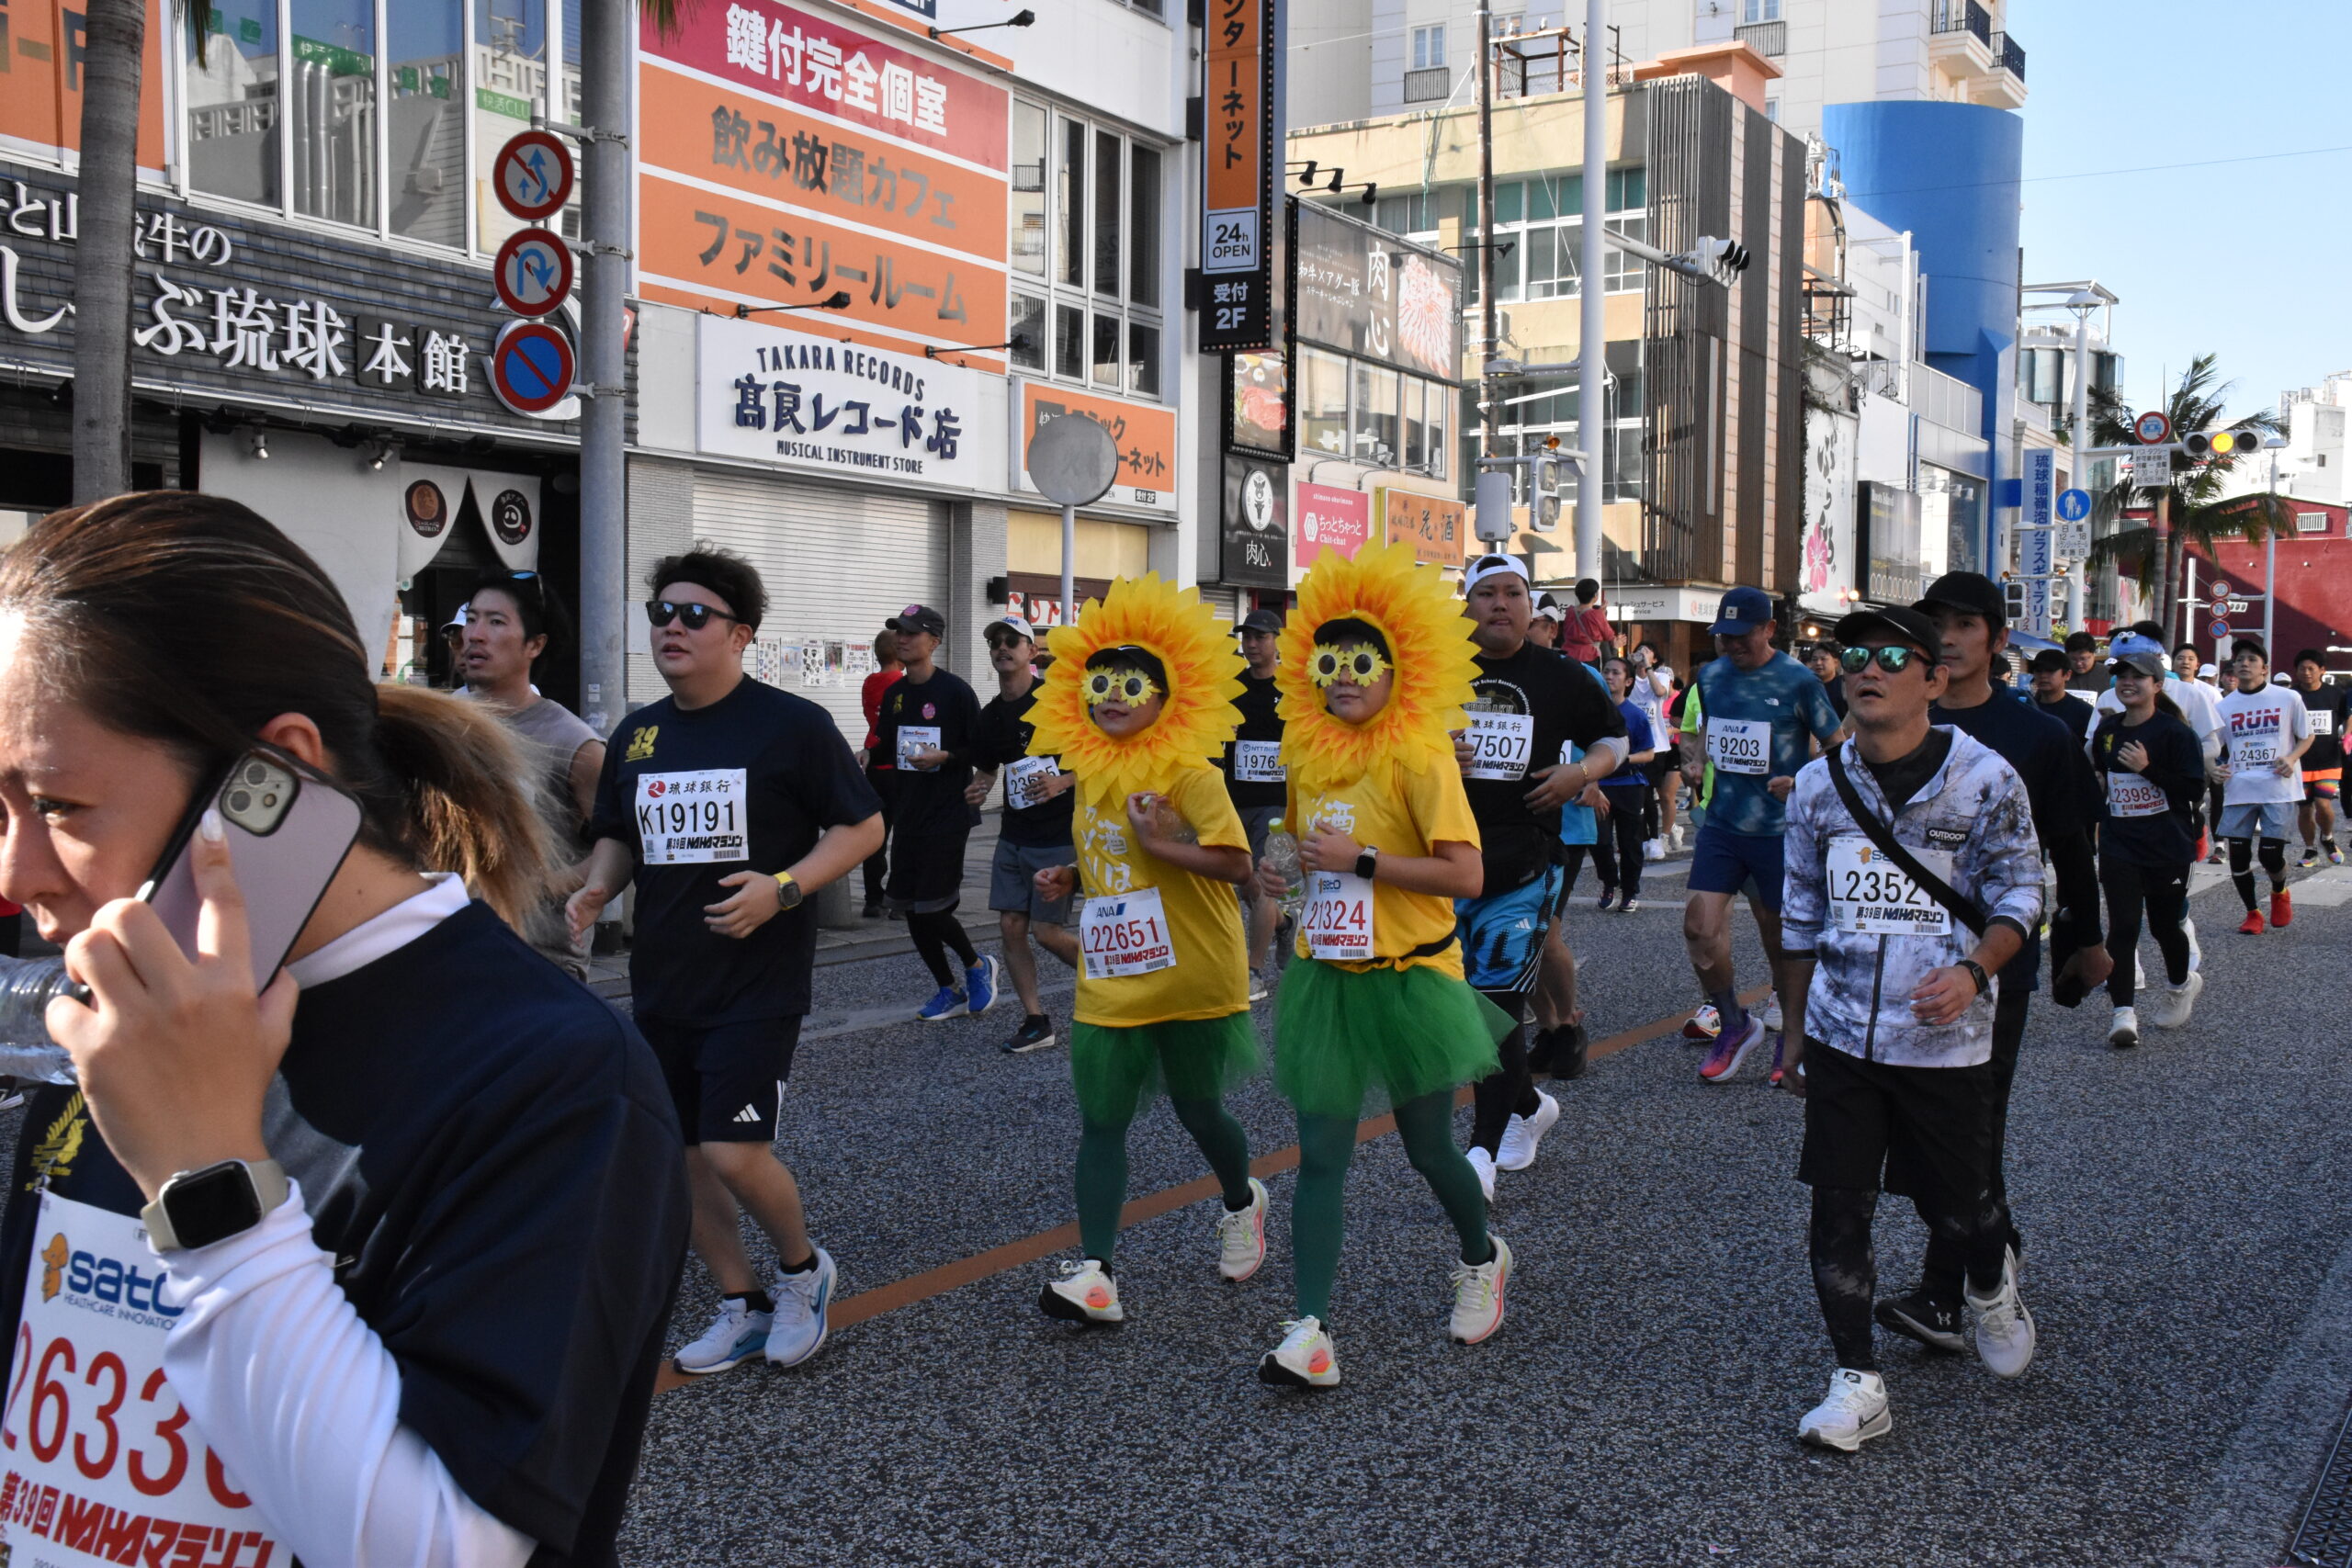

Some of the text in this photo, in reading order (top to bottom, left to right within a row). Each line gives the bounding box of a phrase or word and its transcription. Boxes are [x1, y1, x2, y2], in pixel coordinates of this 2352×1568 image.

[726, 5, 946, 137] 鍵付完全個室
[711, 105, 957, 230] 飲み放題カフェ
[1213, 245, 1250, 258] OPEN
[695, 210, 968, 326] ファミリールーム
[1214, 282, 1249, 303] 受付
[1364, 241, 1390, 356] 肉心
[0, 244, 469, 394] しぶ琉球 本館
[1216, 307, 1246, 330] 2F
[757, 345, 925, 401] TAKARA RECORDS
[777, 440, 923, 475] MUSICAL INSTRUMENT STORE
[1319, 513, 1362, 536] ちっとちゃっと
[1246, 539, 1270, 567] 肉心
[1472, 719, 1521, 732] 琉球銀行
[2231, 708, 2280, 732] RUN
[1459, 733, 1526, 760] 7507
[1720, 737, 1759, 757] 9203
[2233, 749, 2277, 761] L24367
[1236, 754, 1281, 769] L1976
[668, 780, 731, 795] 琉球銀行
[639, 800, 735, 835] K19191
[1929, 829, 1966, 840] OUTDOOR
[1829, 870, 1936, 907] L2352
[1096, 906, 1115, 918] ANA
[1081, 917, 1159, 953] L22651
[63, 1293, 178, 1331] HEALTHCARE INNOVATIO
